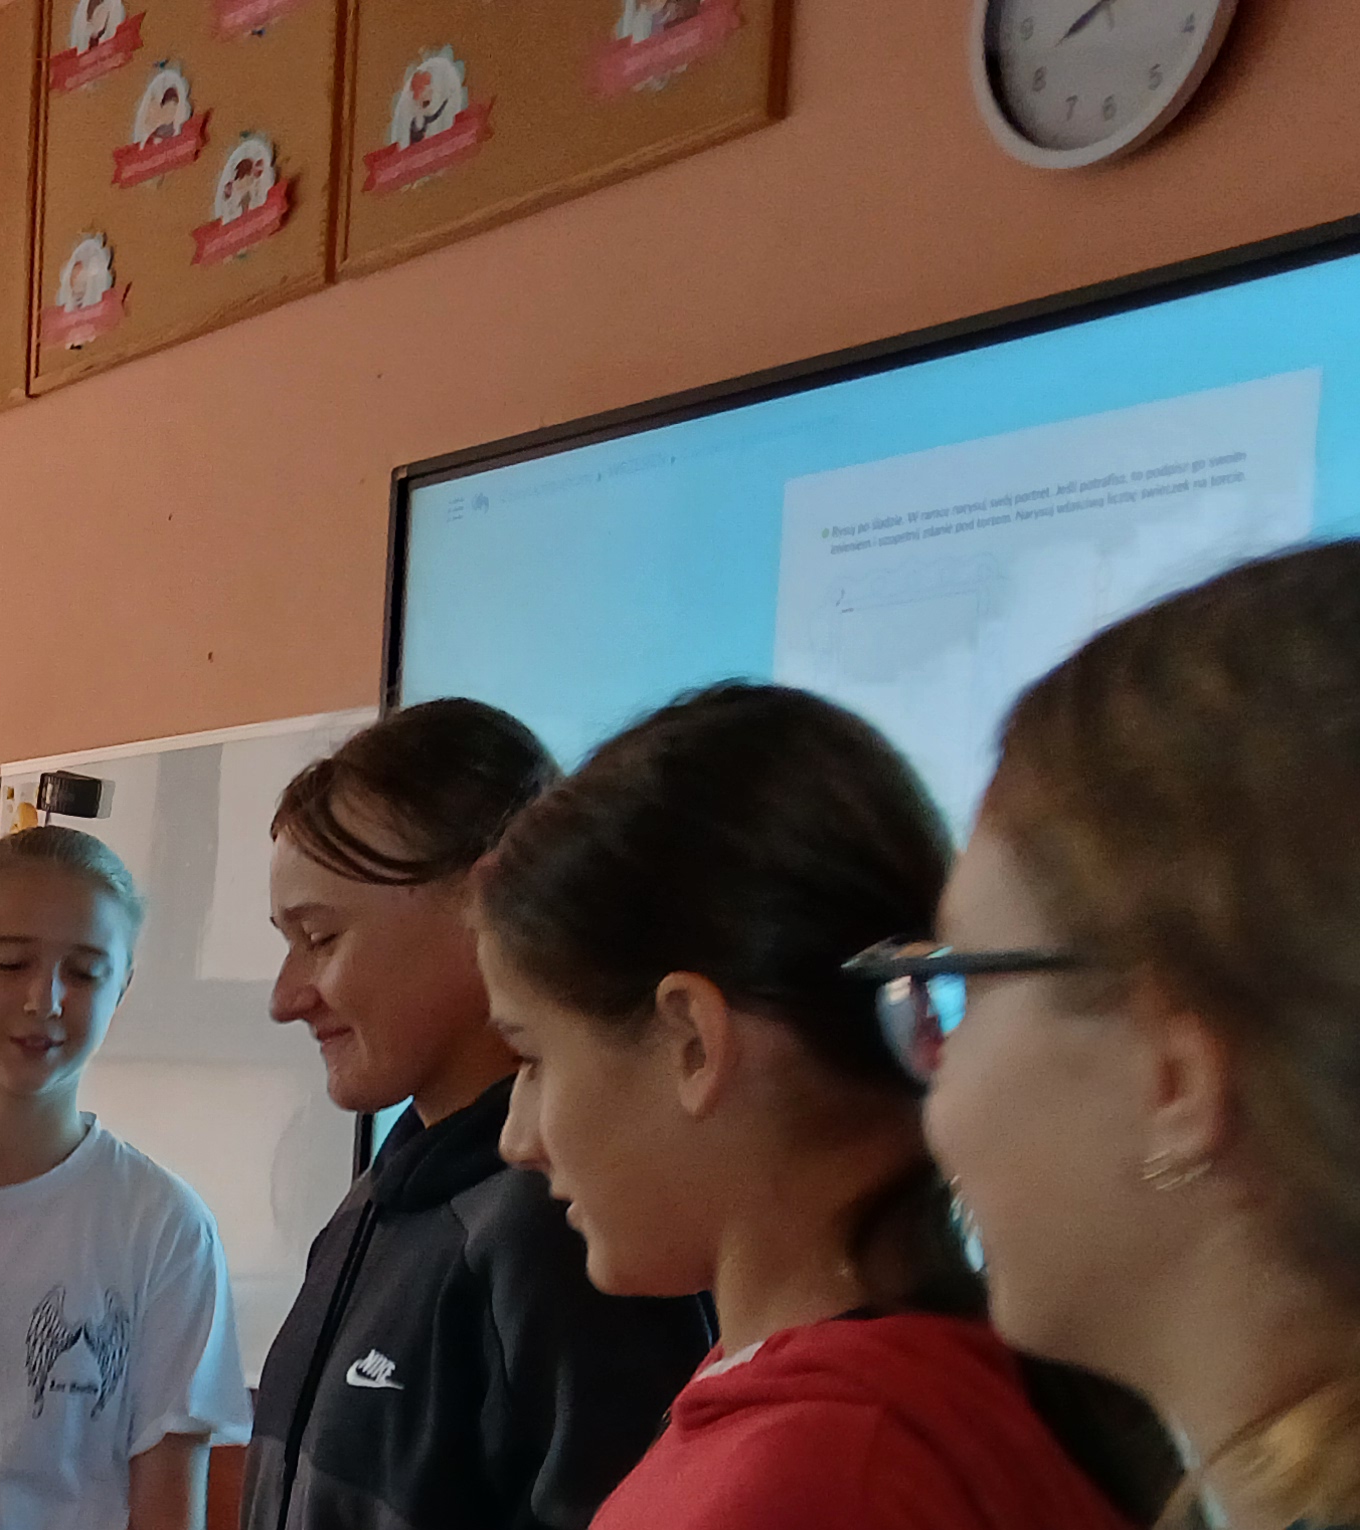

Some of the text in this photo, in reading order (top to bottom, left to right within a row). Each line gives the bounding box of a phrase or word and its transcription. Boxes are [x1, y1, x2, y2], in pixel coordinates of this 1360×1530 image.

[1032, 65, 1047, 92] 8
[1065, 94, 1079, 122] 7
[1102, 93, 1117, 121] 6
[359, 1348, 395, 1384] NIKE
